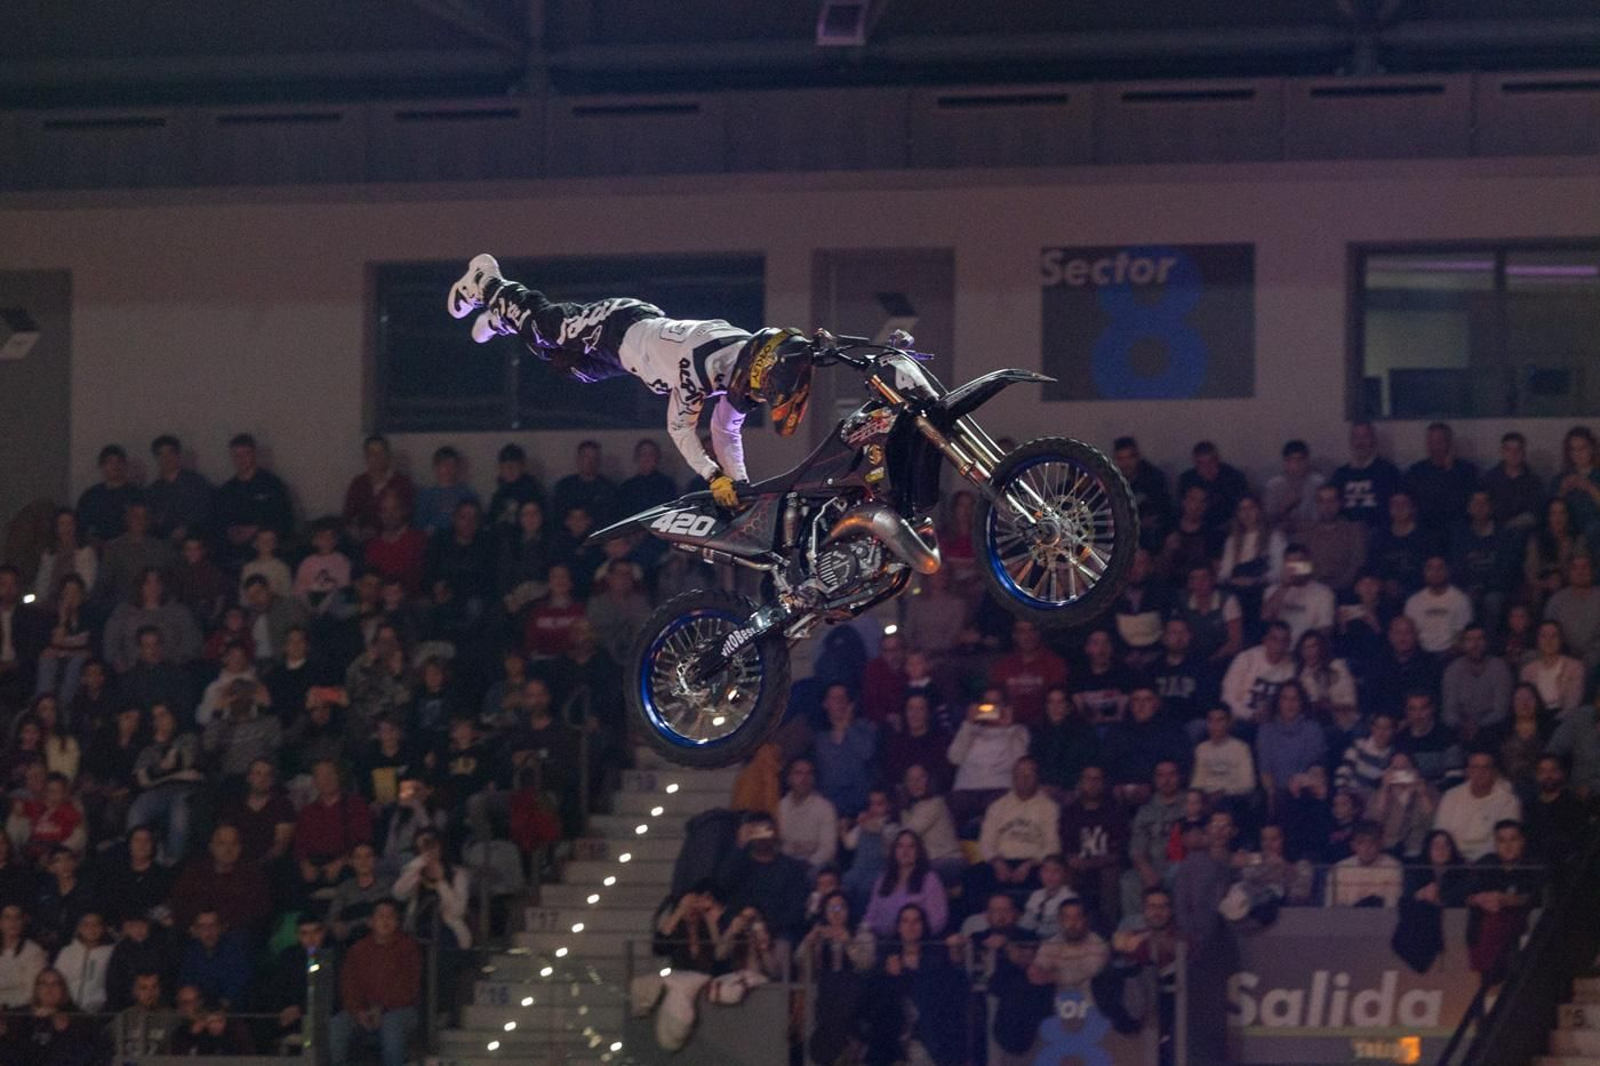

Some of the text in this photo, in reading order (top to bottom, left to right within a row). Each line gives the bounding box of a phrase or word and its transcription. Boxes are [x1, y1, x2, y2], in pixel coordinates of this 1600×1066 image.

[1042, 250, 1177, 286] Sector
[1092, 245, 1208, 400] 8
[650, 511, 717, 537] 420
[1226, 969, 1444, 1027] Salida
